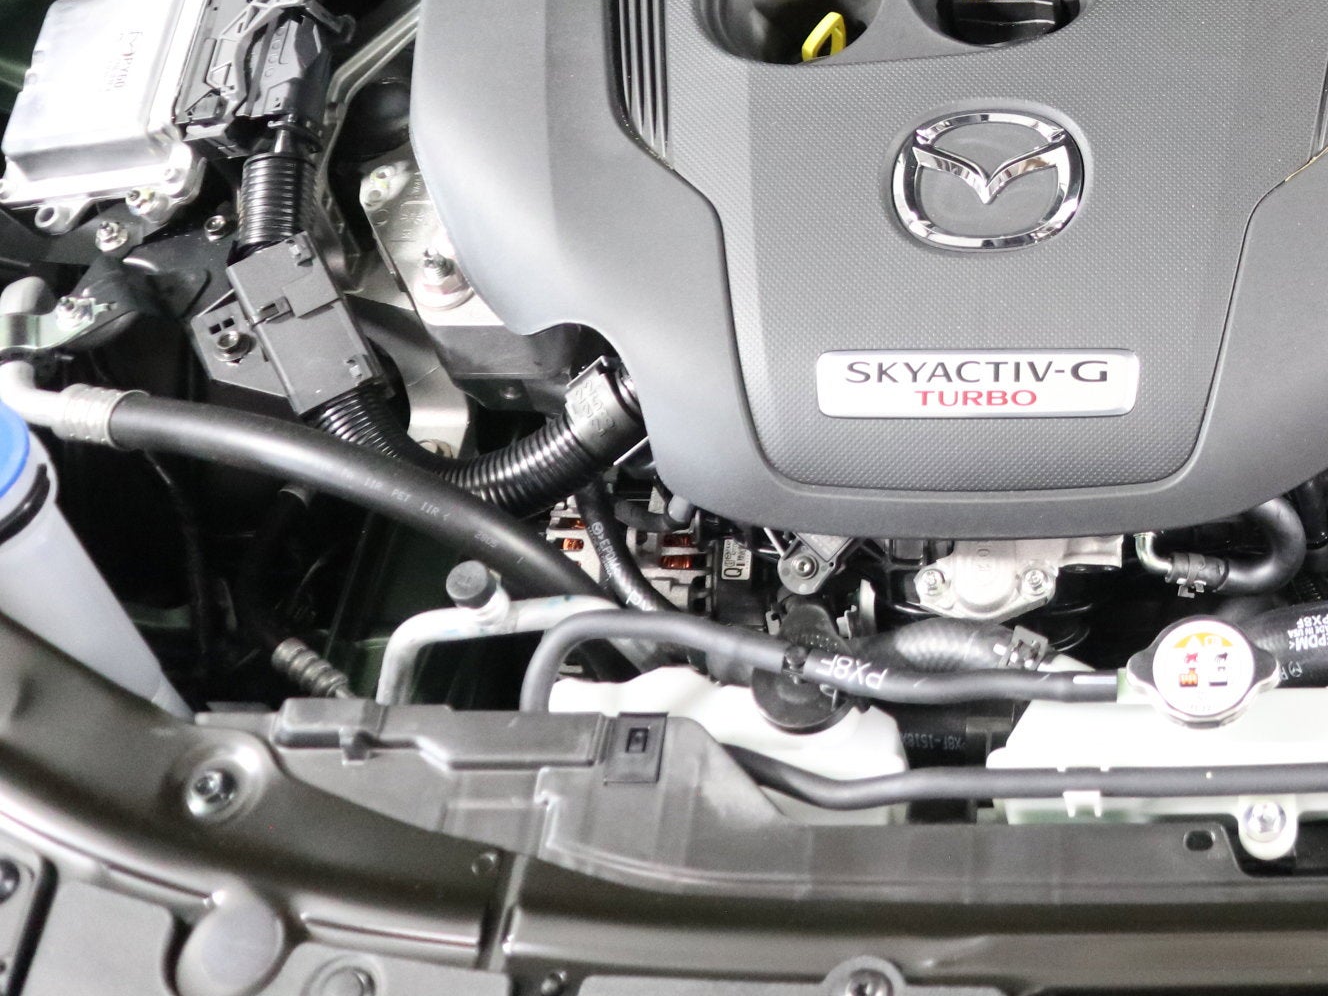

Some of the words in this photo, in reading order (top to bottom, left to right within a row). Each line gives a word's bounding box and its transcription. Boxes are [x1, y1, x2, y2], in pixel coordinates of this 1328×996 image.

[845, 360, 1109, 384] SKYACTIV-G
[914, 390, 1038, 407] TURBO
[723, 567, 743, 578] Q
[815, 654, 889, 690] PX8F
